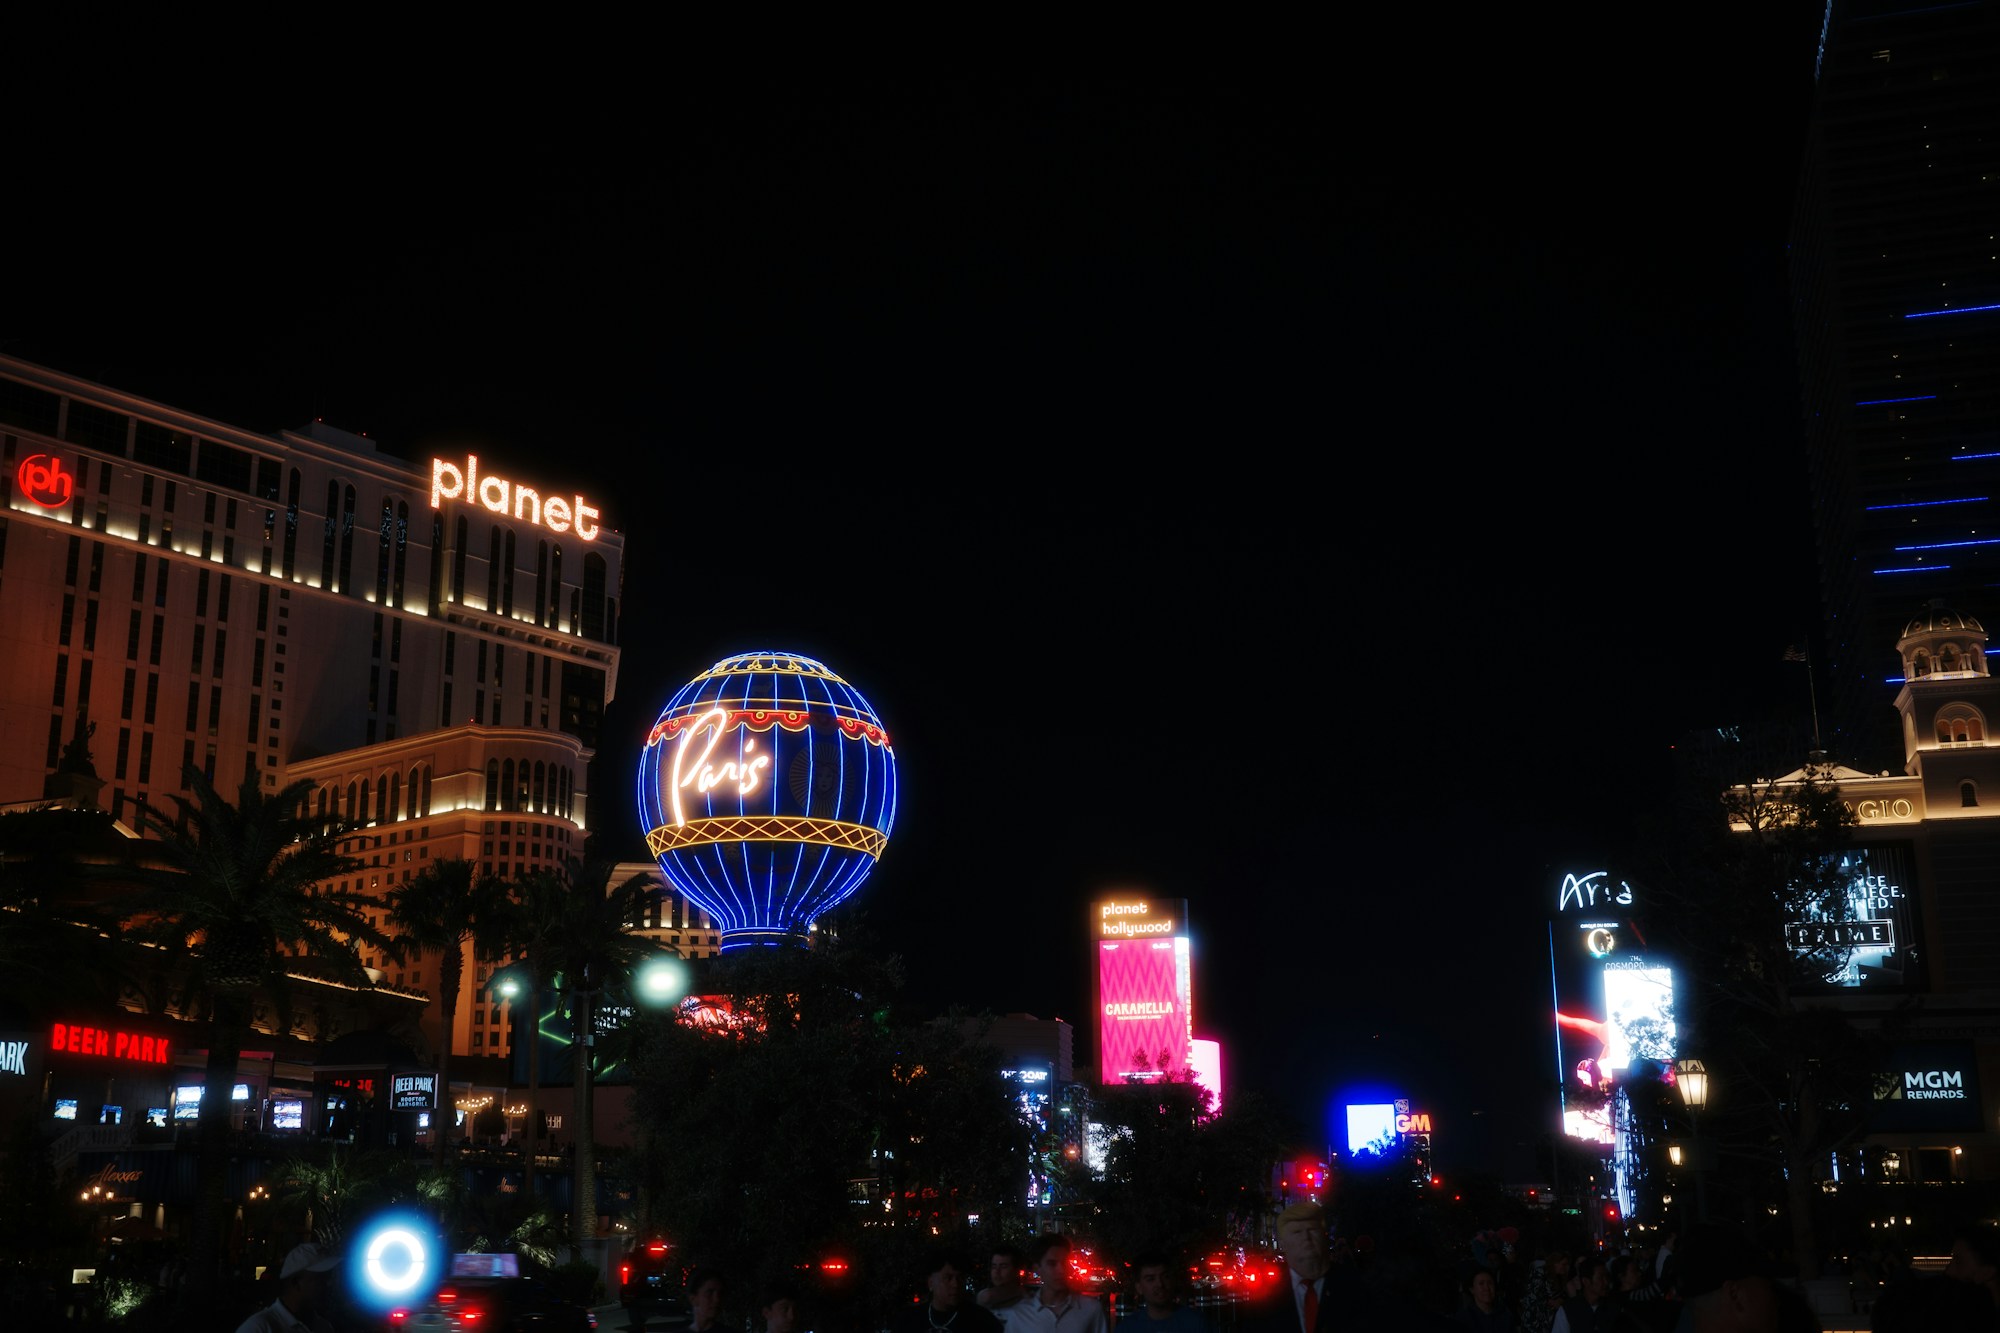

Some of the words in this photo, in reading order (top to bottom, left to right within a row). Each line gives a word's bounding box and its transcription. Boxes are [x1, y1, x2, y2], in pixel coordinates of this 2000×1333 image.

[25, 457, 73, 497] ph
[430, 454, 599, 541] planet
[671, 707, 769, 828] Paris
[1102, 902, 1148, 919] planet
[1103, 920, 1172, 937] hollywood
[1106, 1002, 1173, 1016] CARAMELLA
[52, 1023, 109, 1057] BEER
[114, 1031, 170, 1064] PARK
[395, 1078, 413, 1093] BEER
[415, 1077, 433, 1092] PARK
[1904, 1071, 1963, 1089] MGM
